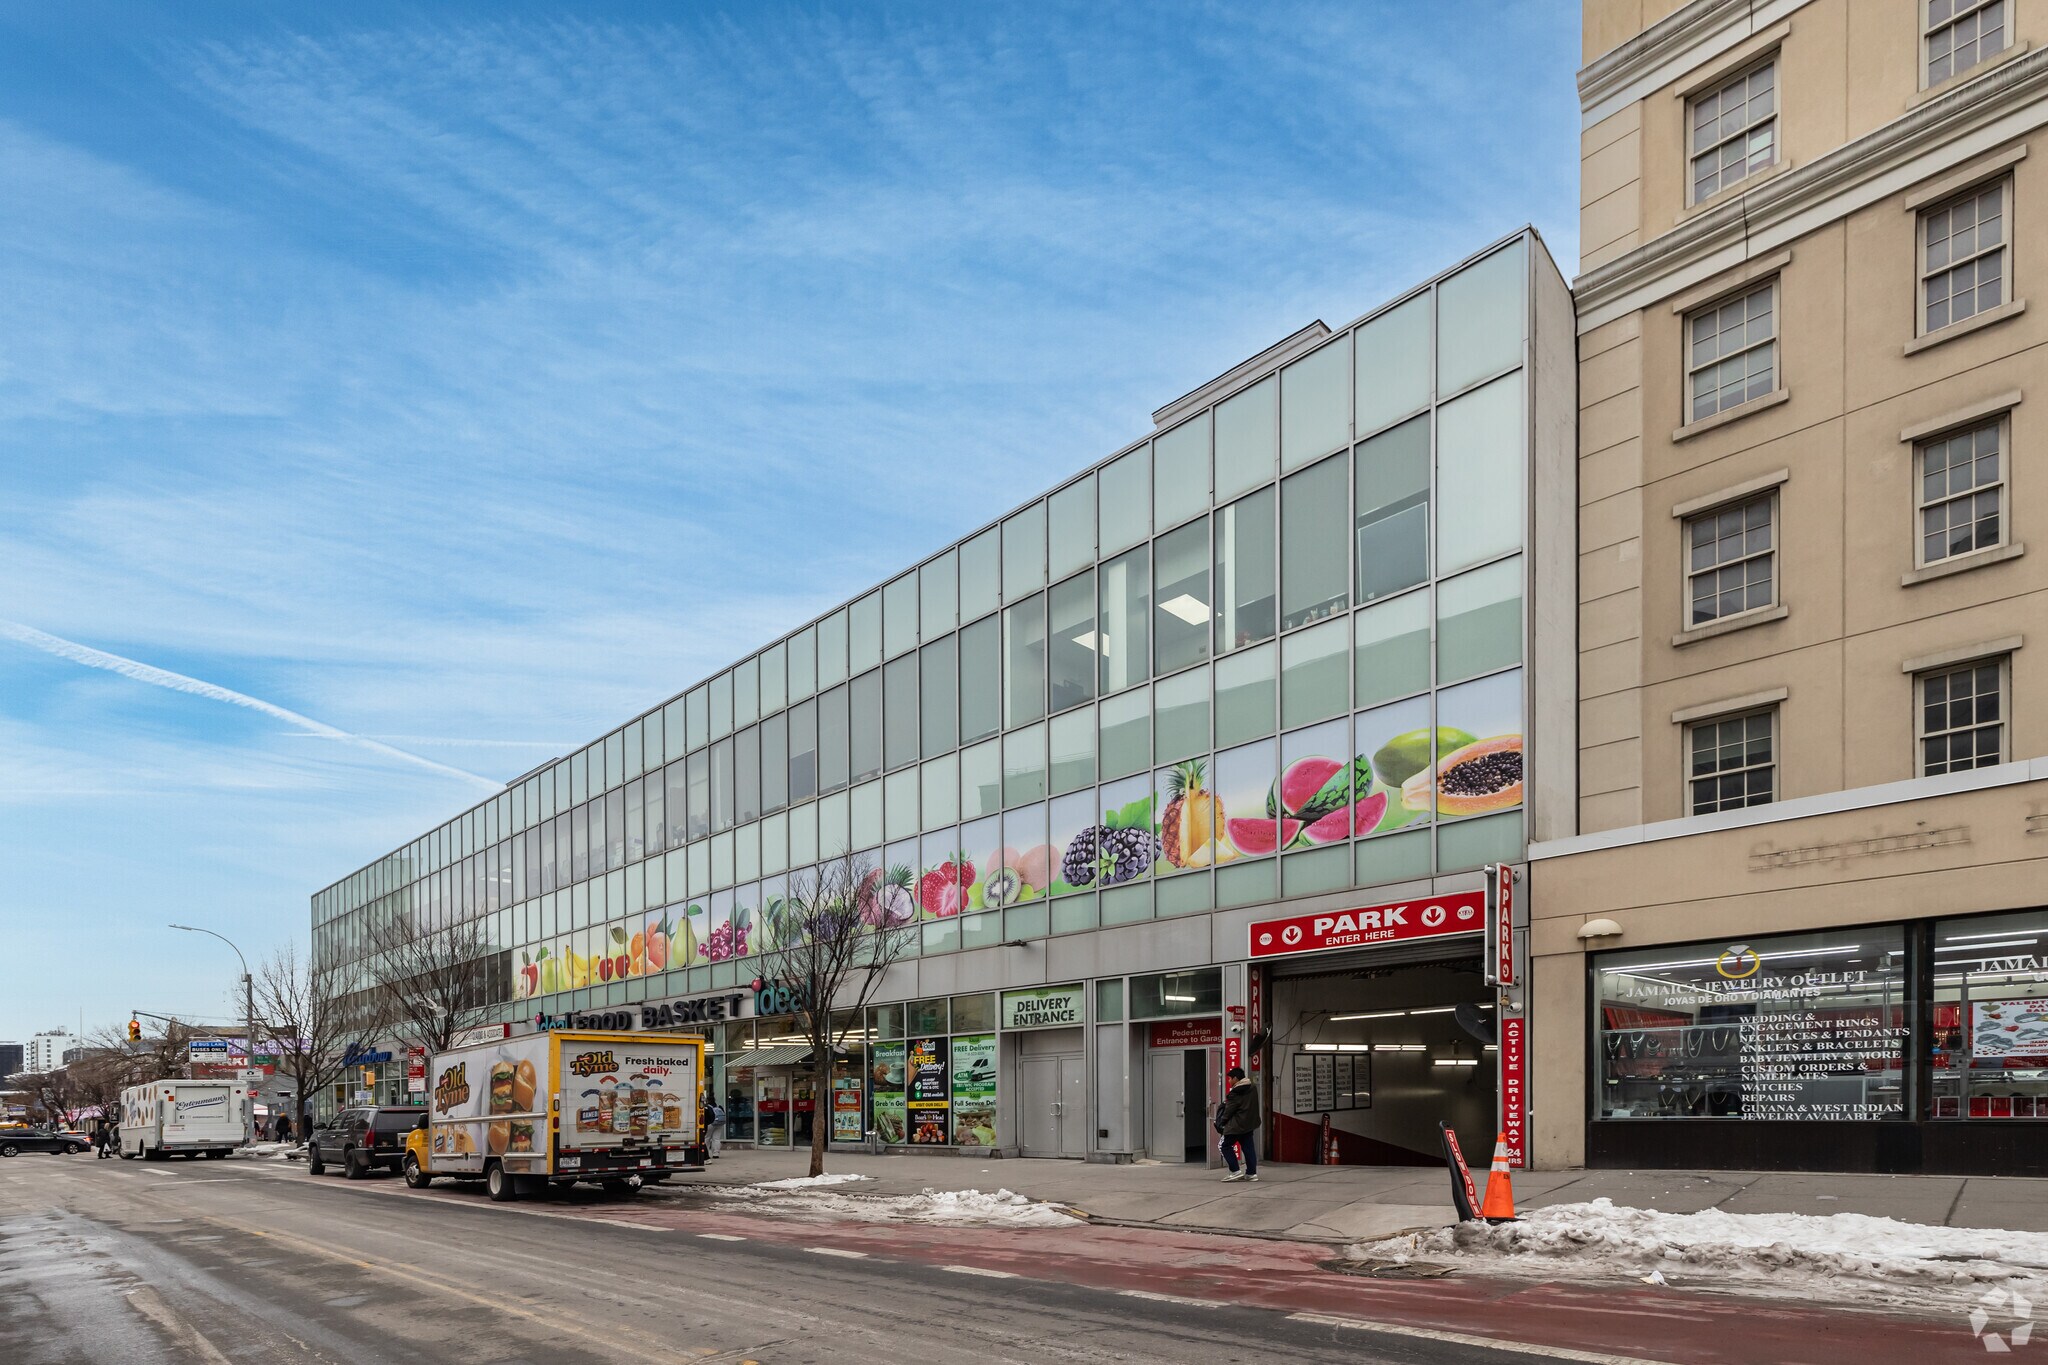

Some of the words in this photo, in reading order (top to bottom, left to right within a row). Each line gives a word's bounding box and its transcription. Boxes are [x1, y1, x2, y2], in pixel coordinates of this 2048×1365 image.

[1314, 906, 1409, 936] PARK
[1500, 889, 1509, 960] PARK
[1326, 934, 1360, 945] ENTER
[1365, 929, 1395, 941] HERE
[1626, 984, 1701, 998] JAMAICA
[1703, 976, 1786, 995] JEWELRY
[1790, 970, 1868, 987] OUTLET
[1017, 996, 1071, 1013] DELIVERY
[1664, 996, 1695, 1006] JOYAS
[1698, 995, 1712, 1004] DE
[1715, 994, 1738, 1002] ORO
[1742, 993, 1750, 1001] Y
[1752, 988, 1821, 1000] DIAMANTES
[641, 994, 744, 1028] BASKET
[1013, 1010, 1075, 1026] ENTRANCE
[1739, 1013, 1802, 1024] WEDDING
[1805, 1012, 1816, 1021] &
[576, 1011, 632, 1030] FOOD
[1740, 1020, 1832, 1032] ENGAGEMENT
[1836, 1017, 1879, 1028] RINGS
[1172, 1028, 1211, 1037] Pedestrian
[1739, 1031, 1818, 1043] NECKLACES
[1821, 1031, 1832, 1039] &
[1836, 1028, 1911, 1039] PENDANTS
[969, 1044, 995, 1052] Delivery
[1157, 1036, 1189, 1045] Entrance
[1190, 1036, 1199, 1044] to
[1508, 1022, 1519, 1070] ACTIVE
[1740, 1042, 1800, 1053] ANKLETS
[1802, 1042, 1813, 1051] &
[1816, 1039, 1900, 1050] BRACELETS
[584, 1051, 614, 1064] Old
[625, 1056, 654, 1065] Fresh
[656, 1058, 689, 1066] baked
[914, 1054, 936, 1064] FREE
[1739, 1054, 1774, 1063] BABY
[1776, 1052, 1840, 1063] JEWELRY
[1843, 1052, 1854, 1060] &
[1857, 1050, 1901, 1059] MORE
[570, 1061, 619, 1077] Tyme
[643, 1066, 672, 1076] daily.
[1741, 1064, 1795, 1073] CUSTOM
[1799, 1063, 1854, 1072] ORDERS
[1857, 1062, 1868, 1071] &
[444, 1061, 466, 1091] Old
[1741, 1072, 1829, 1082] NAMEPLATES
[1742, 1083, 1803, 1092] WATCHES
[435, 1085, 470, 1115] Tyme
[1741, 1094, 1796, 1102] REPAIRS
[1506, 1079, 1520, 1144] DRIVEWAY
[1741, 1104, 1794, 1113] GUYANA
[1797, 1104, 1808, 1112] &
[1811, 1104, 1850, 1112] WEST
[1853, 1104, 1904, 1112] INDIAN
[1741, 1112, 1803, 1121] JEWELRY
[1805, 1112, 1882, 1121] AVAILABLE
[1449, 1133, 1465, 1170] SLOW
[1507, 1148, 1520, 1157] 24
[1466, 1175, 1480, 1214] DOWN
